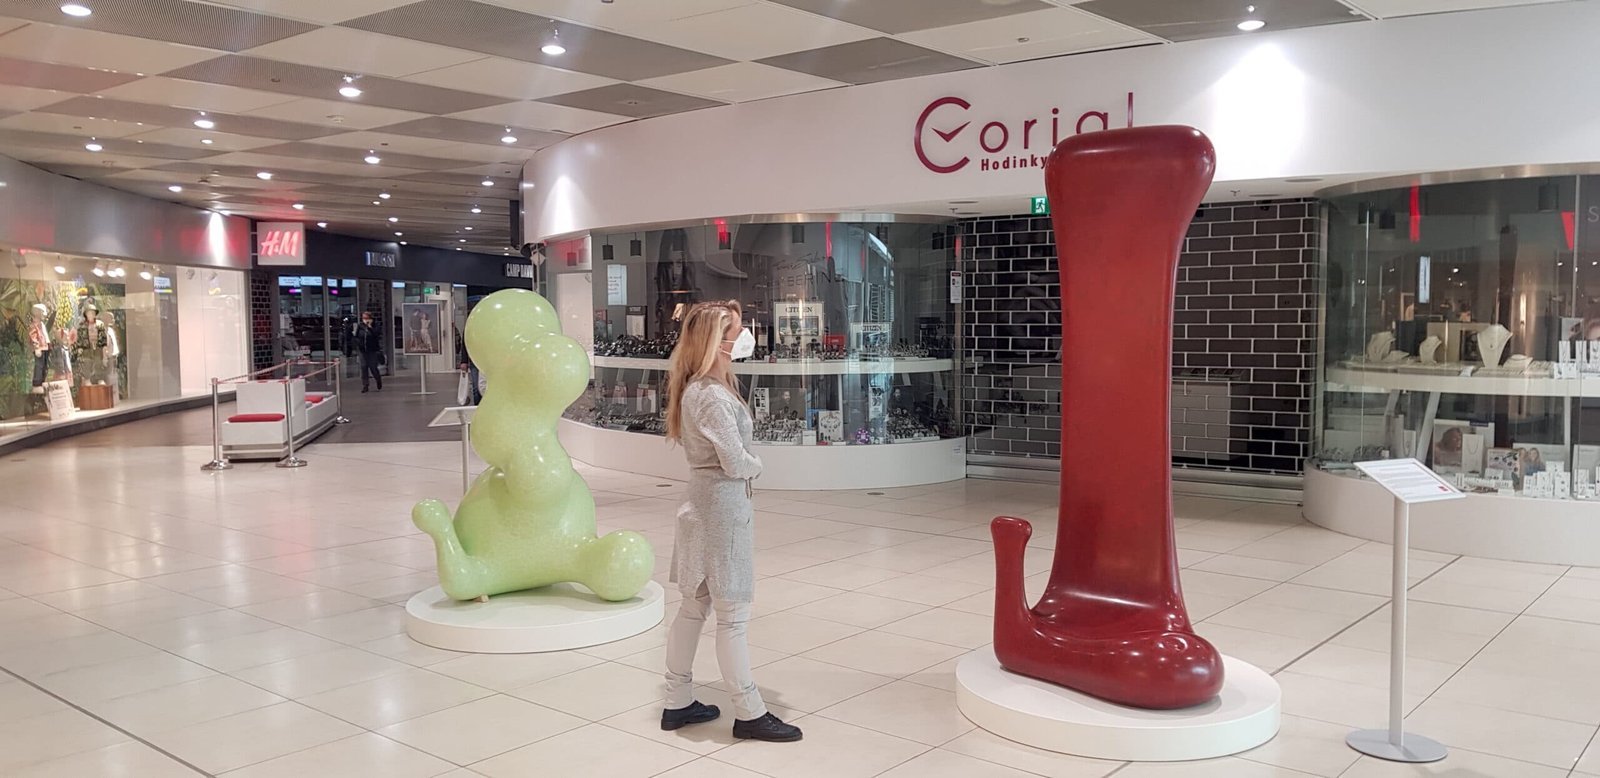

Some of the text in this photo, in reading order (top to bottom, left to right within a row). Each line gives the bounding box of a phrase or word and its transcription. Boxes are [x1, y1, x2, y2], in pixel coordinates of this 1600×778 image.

[914, 92, 1134, 173] Corial
[981, 154, 1048, 171] Hodinky
[261, 230, 301, 257] H&M
